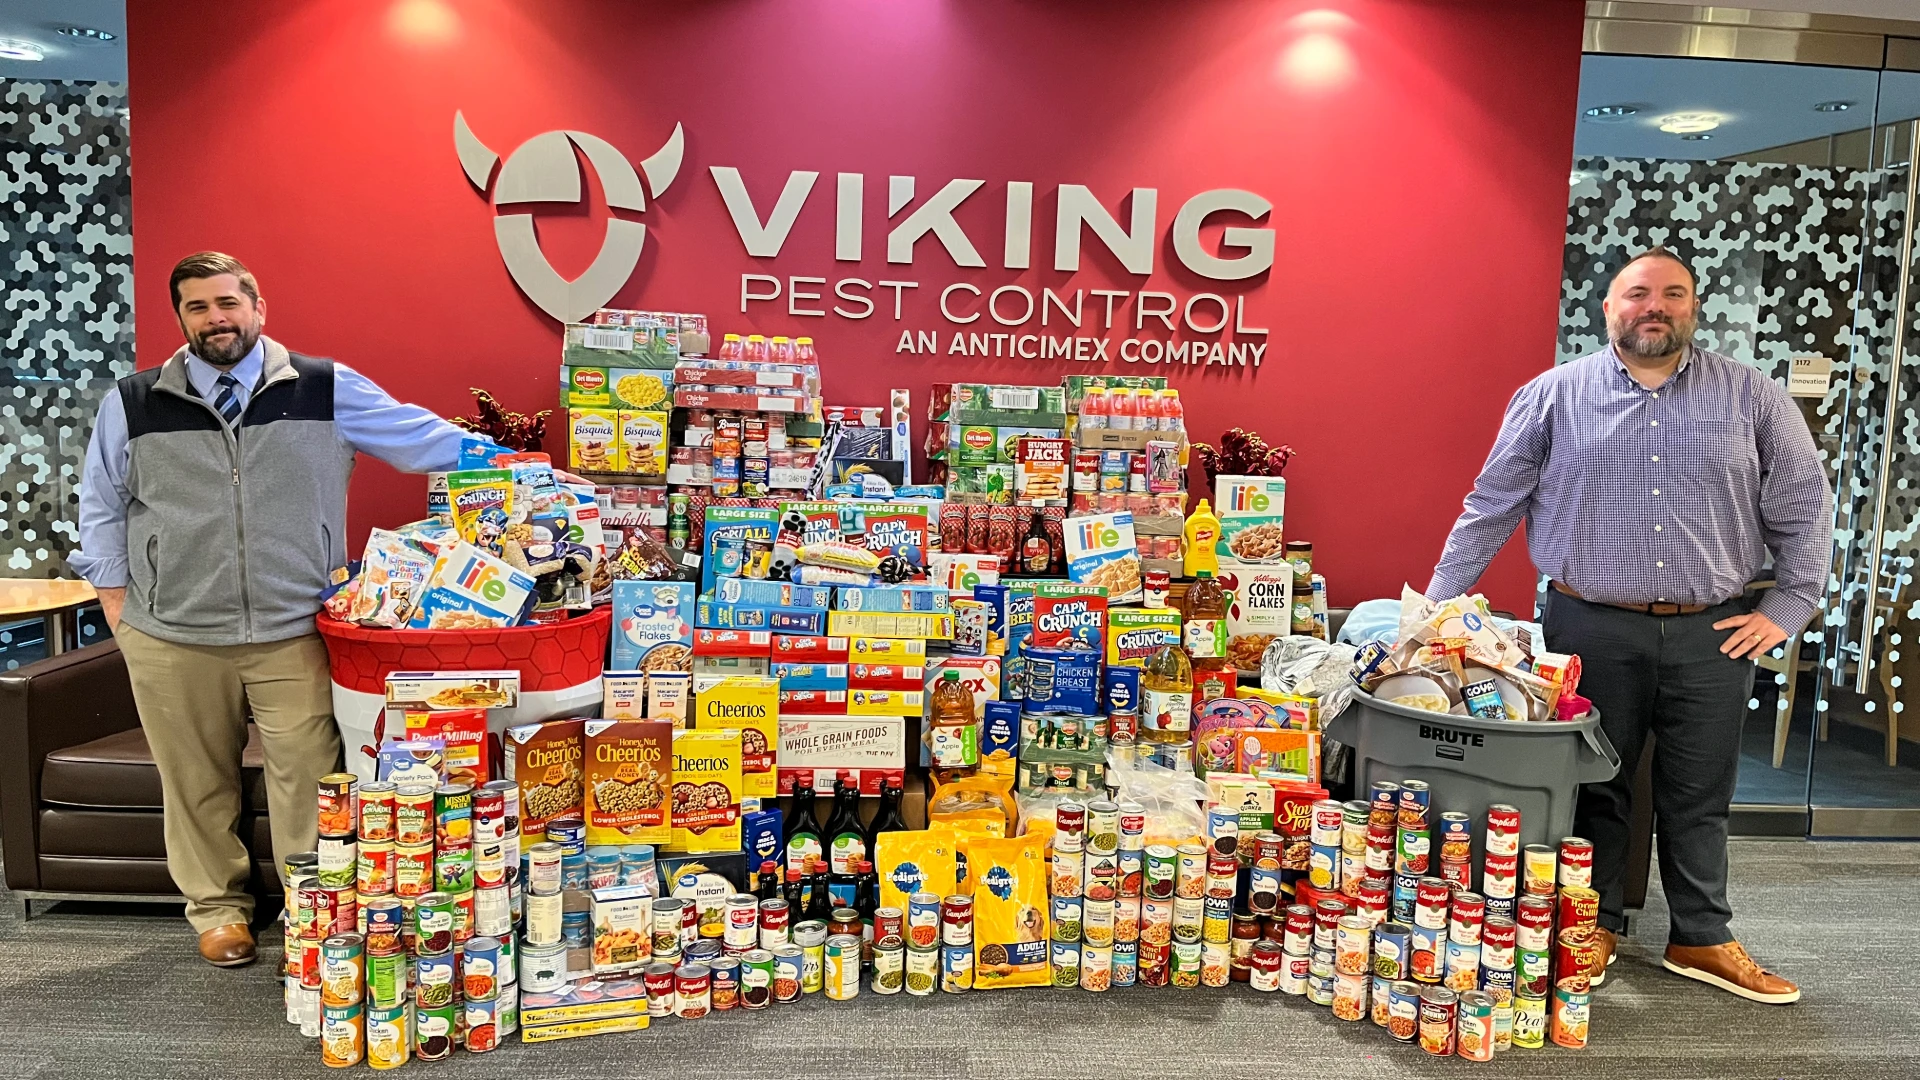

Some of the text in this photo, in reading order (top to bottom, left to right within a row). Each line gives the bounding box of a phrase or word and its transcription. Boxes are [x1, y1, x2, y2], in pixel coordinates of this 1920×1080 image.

[710, 166, 1275, 280] VIKING
[740, 275, 1269, 334] PEST CONTROL
[897, 330, 1268, 367] AN ANTICIMEX COMPANY
[684, 369, 707, 378] Chicken
[686, 394, 708, 403] Chicken
[575, 425, 613, 436] Bisquick
[624, 427, 662, 437] Bisquick
[1025, 449, 1063, 460] JACK
[789, 474, 806, 482] 24619
[430, 494, 449, 502] GRIT
[456, 490, 506, 505] CRUNCH
[1231, 486, 1270, 512] life
[713, 509, 771, 519] LARGE SIZE
[863, 505, 919, 514] LARGE SIZE
[601, 512, 650, 526] mpbell's
[807, 519, 832, 529] AP'N
[872, 519, 907, 534] CAP'N
[744, 527, 770, 539] ALL
[1079, 518, 1120, 550] life
[394, 563, 420, 572] Toast
[1072, 561, 1098, 571] original
[388, 569, 424, 581] Crunch
[456, 556, 506, 602] life
[949, 564, 980, 590] ife
[1254, 574, 1282, 582] Kellogg's
[1044, 586, 1100, 595] LARGE SIZE
[1248, 583, 1284, 596] CORN
[431, 592, 463, 609] original
[1248, 598, 1285, 608] FLAKES
[1053, 602, 1086, 616] CAP'N
[1038, 611, 1102, 632] CRUNCH
[1118, 614, 1174, 623] LARGE SIZE
[636, 622, 674, 632] Frosted
[639, 632, 671, 641] Flakes
[1195, 635, 1212, 643] Apple
[988, 664, 994, 672] 3
[1056, 668, 1094, 678] CHICKEN
[1056, 678, 1089, 687] BREAST
[1466, 682, 1494, 697] GOYA
[707, 700, 766, 718] Cheerios
[412, 730, 483, 742] Pearl Milling
[786, 726, 887, 750] WHOLE GRAIN FOODS
[1420, 724, 1484, 747] BRUTE
[546, 737, 578, 750] Honey Nut
[619, 738, 656, 748] Honey Nut
[816, 743, 847, 752] EVERY
[852, 739, 878, 747] MEAL
[527, 742, 582, 768] Cheerios
[596, 745, 661, 762] Cheerios
[672, 755, 729, 772] Cheerios
[546, 774, 565, 782] HONEY
[445, 795, 471, 807] MISSION
[684, 813, 725, 822] CHOLESTEROL
[1277, 801, 1311, 824] Stov
[594, 814, 660, 823] LOWER CHOLESTEROL
[524, 821, 545, 831] LOWER
[590, 876, 616, 889] SKIPPY
[885, 871, 929, 884] Pedigree
[980, 874, 1018, 886] Pedigree
[696, 887, 725, 896] Instant
[1017, 941, 1046, 952] ADULT
[328, 949, 350, 958] HEARTY
[326, 964, 349, 972] Chicken
[1487, 970, 1512, 980] GOYA
[1569, 996, 1588, 1005] HEARTY
[1461, 1003, 1478, 1015] HEARTY
[1565, 1009, 1586, 1017] Chicken
[327, 1010, 348, 1020] HEARTY
[370, 1010, 390, 1020] HEARTY
[326, 1026, 347, 1034] Chicken
[369, 1026, 388, 1034] Chicken
